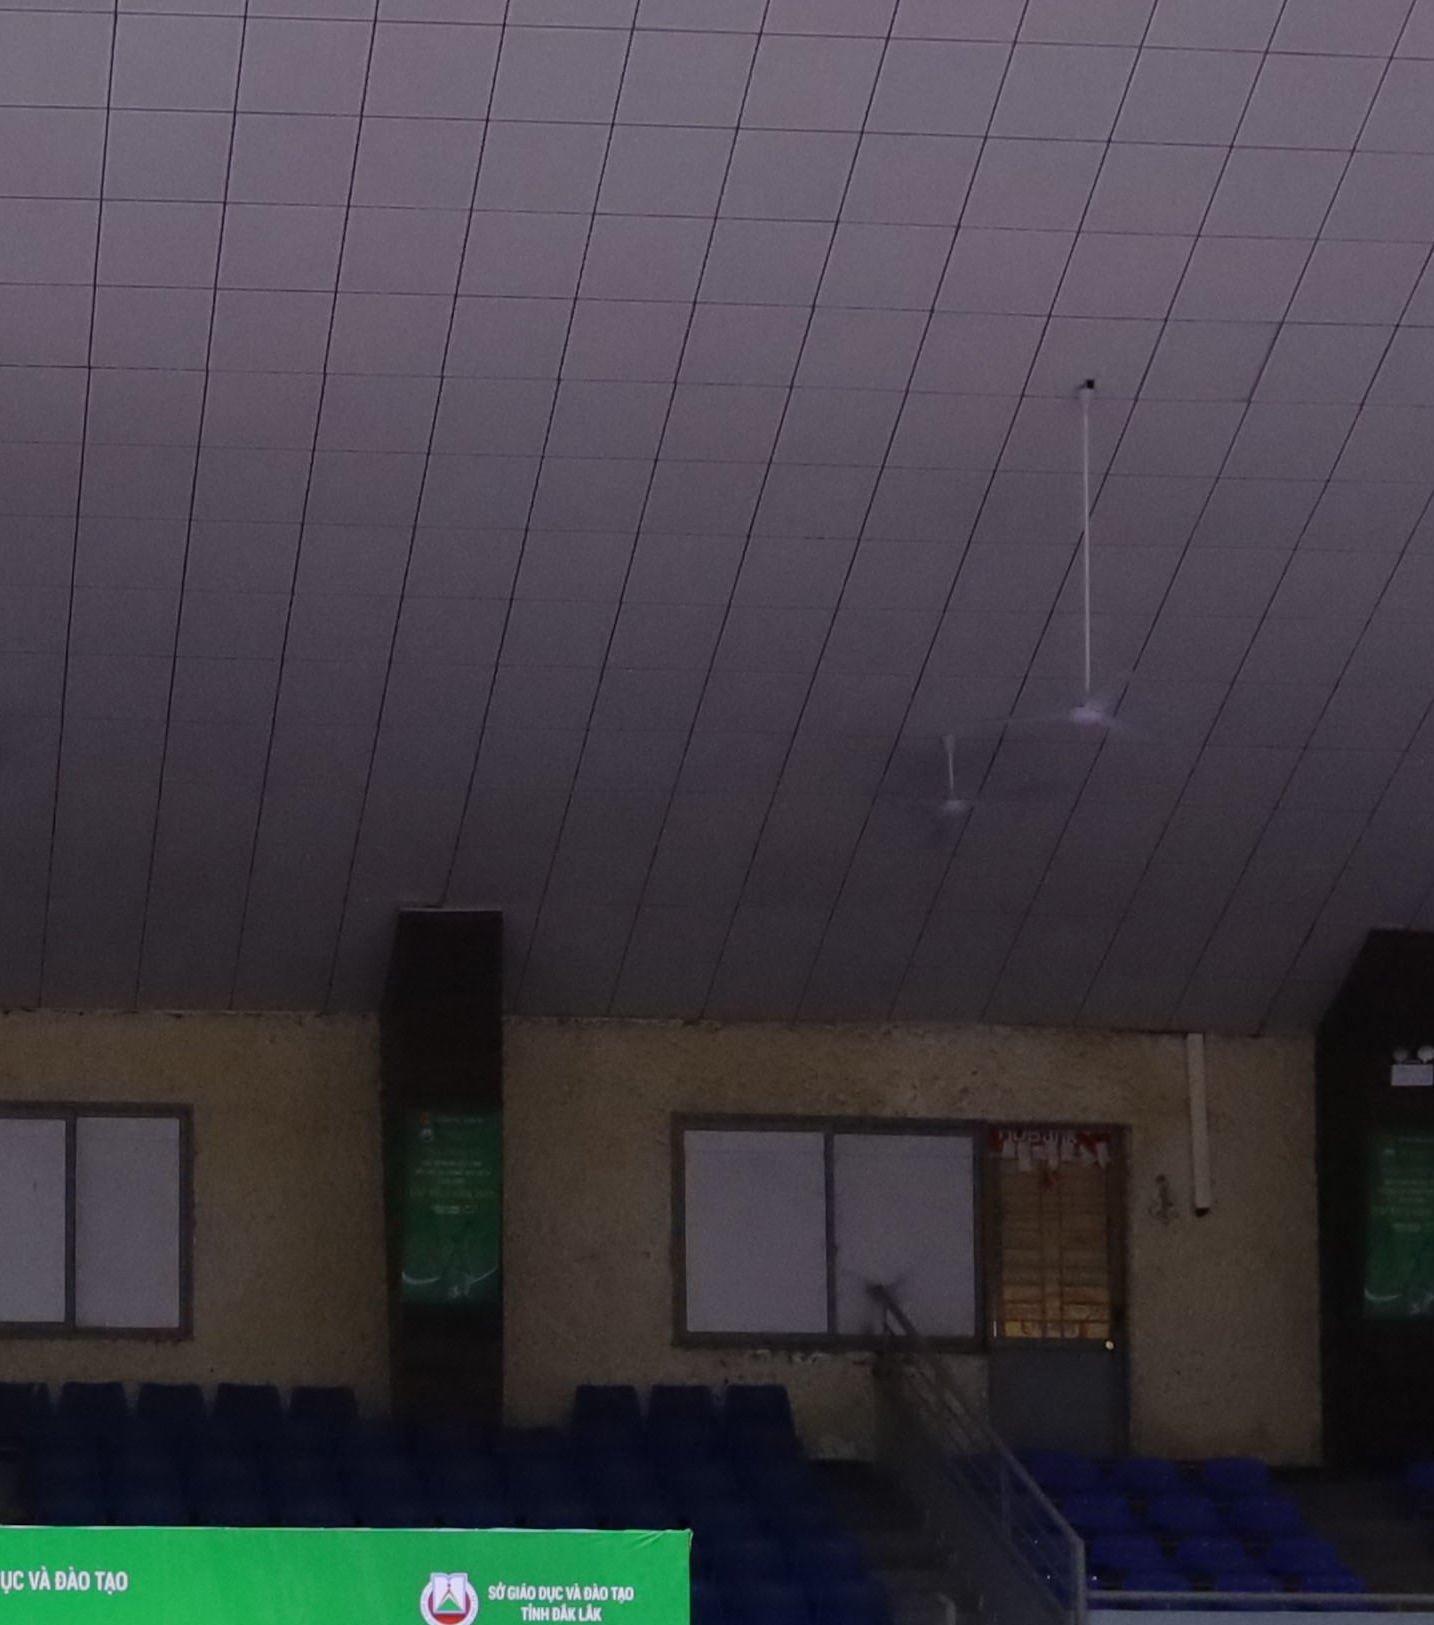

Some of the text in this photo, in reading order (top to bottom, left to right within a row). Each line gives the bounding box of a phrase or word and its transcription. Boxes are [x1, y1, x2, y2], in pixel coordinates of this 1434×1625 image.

[28, 1566, 51, 1590] VÀ
[54, 1566, 91, 1591] ĐÀO
[94, 1571, 128, 1595] TẠO
[488, 1582, 634, 1603] SỞ GIÁO DỤC VÀ ĐÀO TẠO
[521, 1604, 550, 1621] TỈNH
